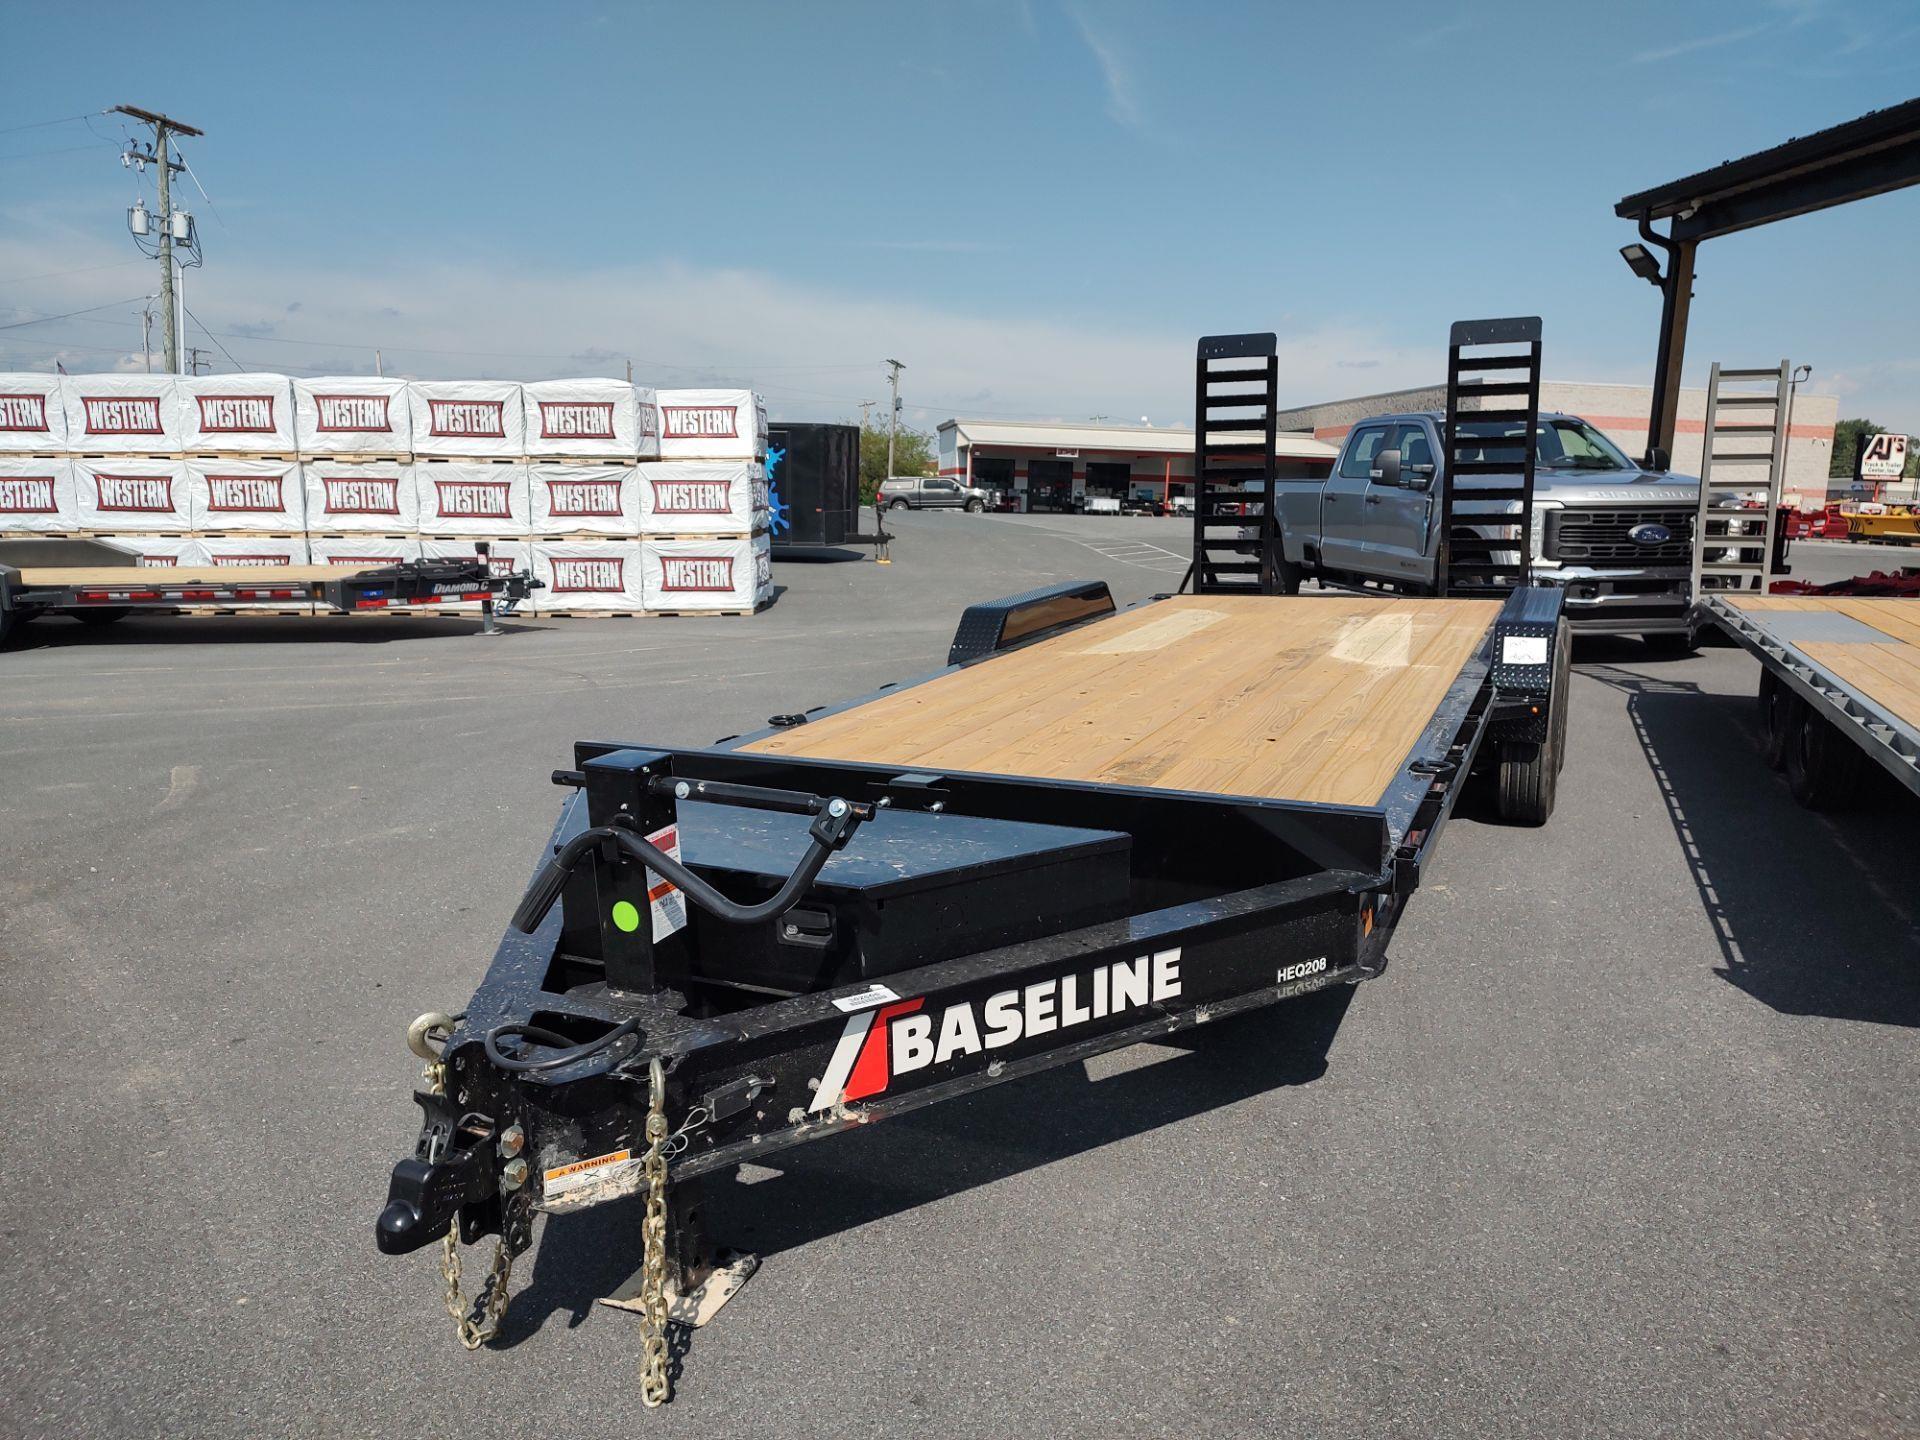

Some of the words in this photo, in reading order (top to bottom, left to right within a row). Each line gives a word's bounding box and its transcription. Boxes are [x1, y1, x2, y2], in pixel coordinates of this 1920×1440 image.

[0, 399, 43, 428] STERN
[87, 400, 158, 430] WESTERN
[202, 399, 271, 428] WESTERN
[319, 399, 385, 428] WESTERN
[433, 403, 500, 433] WESTERN
[543, 405, 611, 435] WESTERN
[667, 409, 733, 435] WESTERN
[0, 480, 51, 509] ESTERN
[99, 478, 169, 509] WESTERN
[210, 479, 279, 508] WESTERN
[327, 481, 394, 510] WESTERN
[440, 484, 506, 514] WESTERN
[551, 484, 617, 512] WESTERN
[656, 483, 726, 511] WESTERN
[433, 582, 479, 594] DIAMOND
[480, 580, 490, 591] C
[554, 560, 619, 589] WESTERN
[665, 560, 730, 588] WESTERN
[1277, 957, 1327, 984] HEQ208
[891, 947, 1183, 1076] BASELINE
[568, 1155, 617, 1173] WARNING
